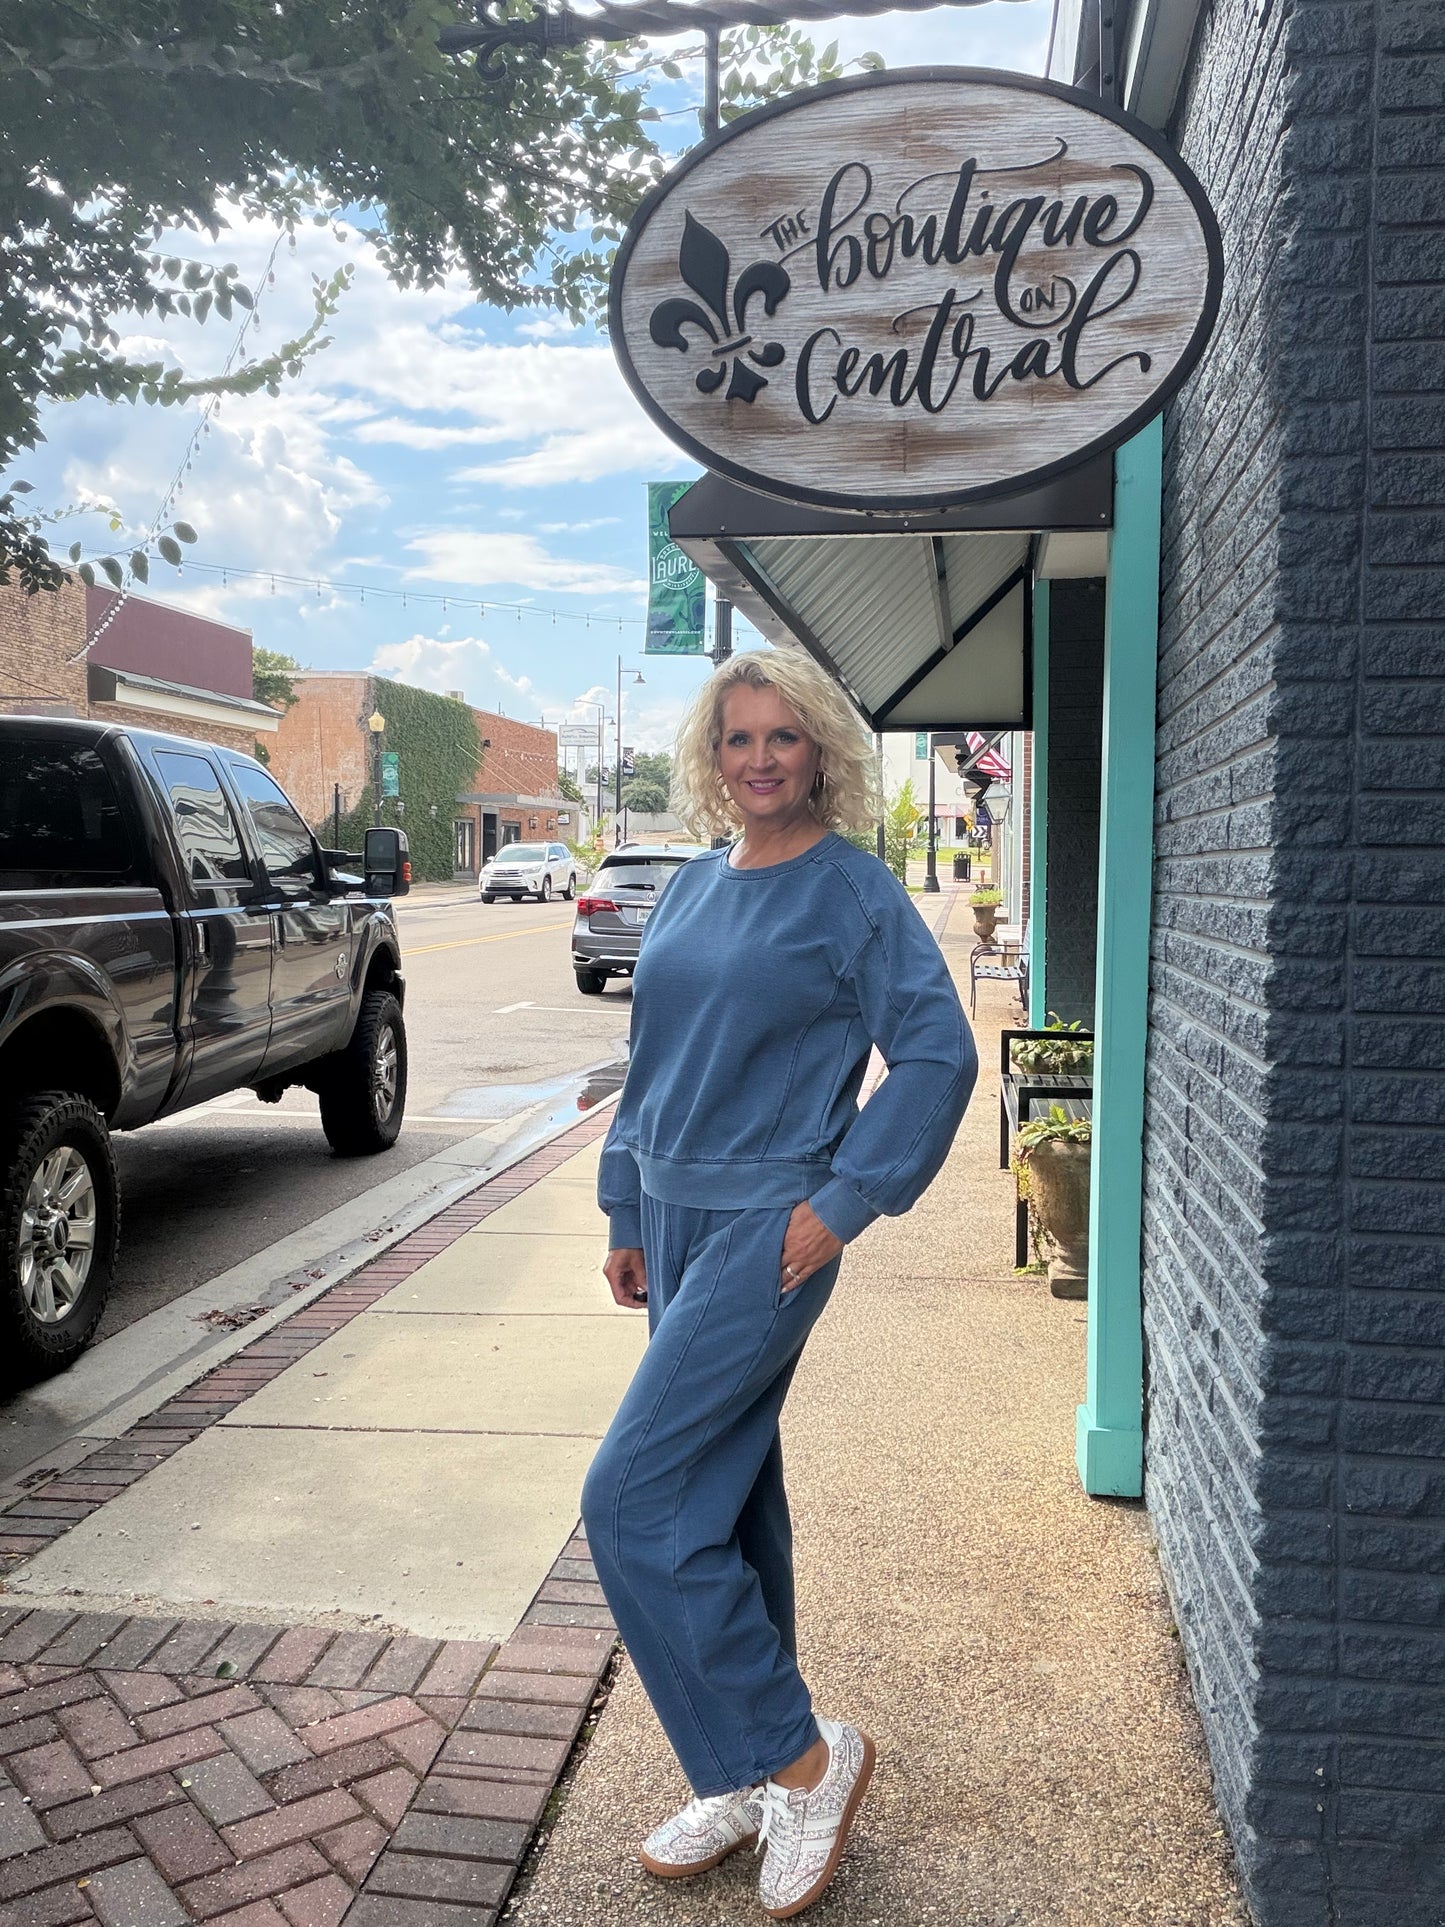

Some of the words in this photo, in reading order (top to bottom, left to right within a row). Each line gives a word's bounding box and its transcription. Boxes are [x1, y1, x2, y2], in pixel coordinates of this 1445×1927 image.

[760, 209, 810, 251] THE
[815, 137, 1155, 328] boutique
[1019, 281, 1058, 313] ON
[794, 247, 1152, 424] Central
